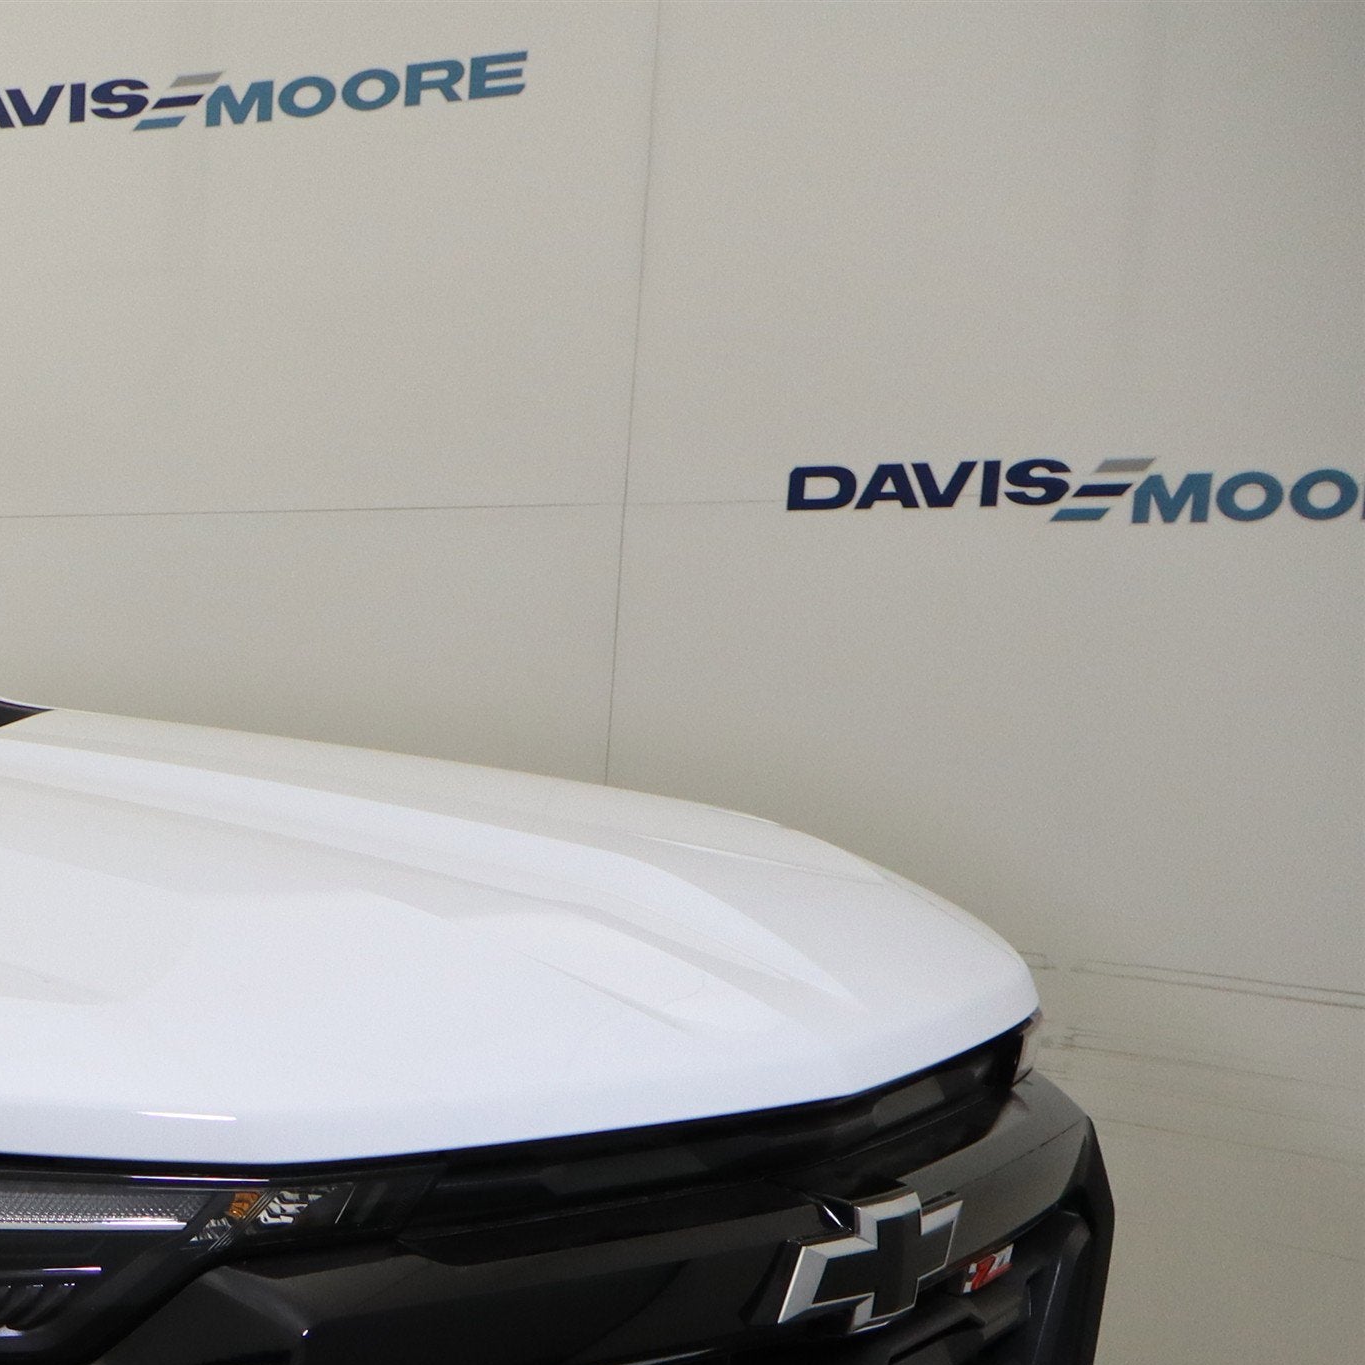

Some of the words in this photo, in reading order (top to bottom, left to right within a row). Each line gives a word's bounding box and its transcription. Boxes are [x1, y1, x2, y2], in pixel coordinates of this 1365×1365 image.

[205, 50, 529, 128] MOORE
[786, 457, 1072, 511] DAVIS
[1131, 468, 1365, 524] MOO
